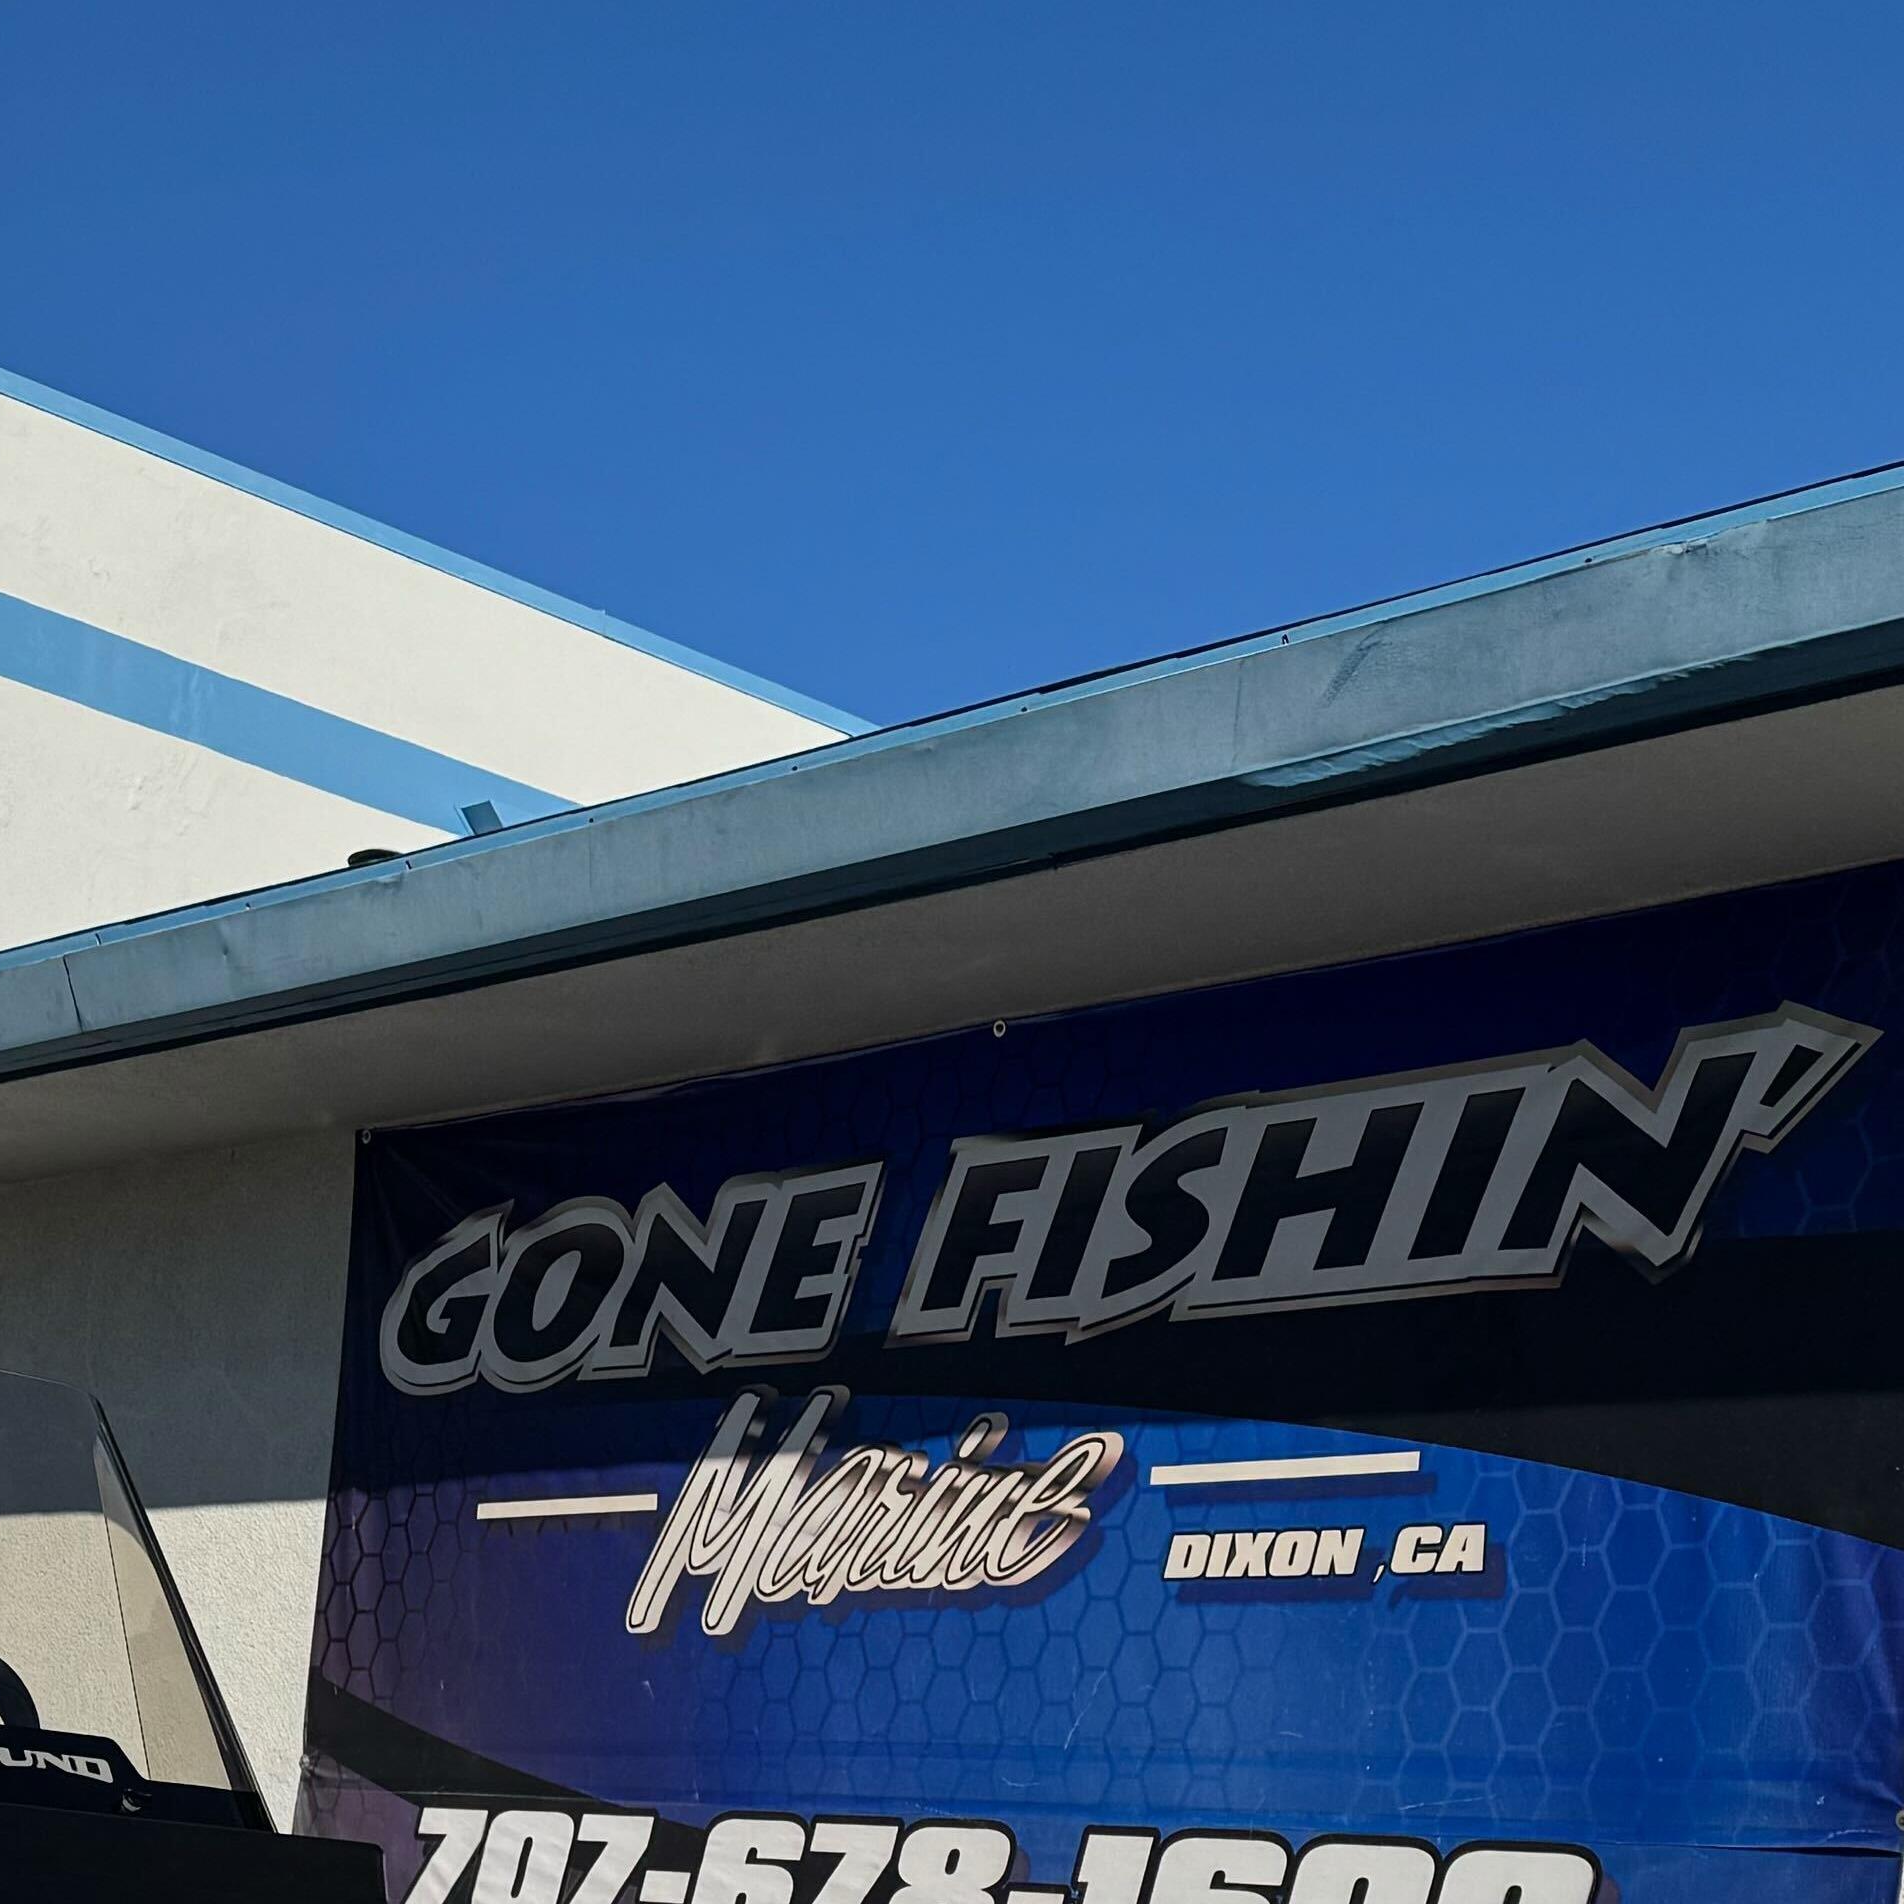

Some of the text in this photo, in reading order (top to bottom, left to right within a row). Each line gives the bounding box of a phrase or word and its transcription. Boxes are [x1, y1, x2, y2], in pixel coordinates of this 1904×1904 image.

[388, 1028, 1874, 1388] GONE FISHIN'
[628, 1383, 1124, 1636] Marine
[1162, 1525, 1366, 1582] DIXON
